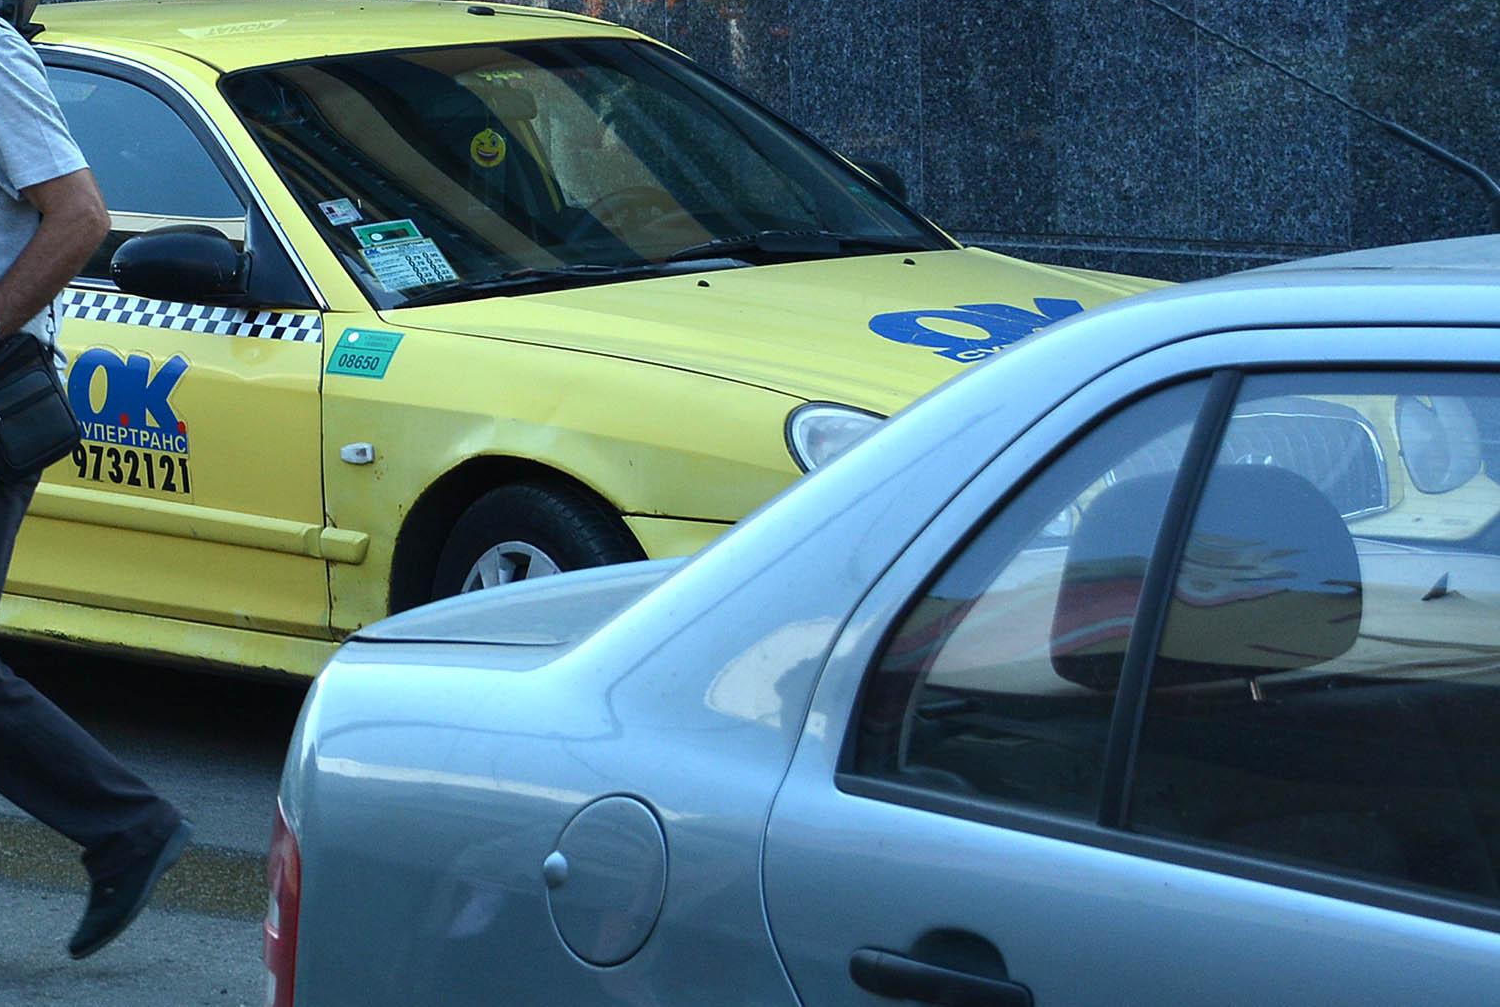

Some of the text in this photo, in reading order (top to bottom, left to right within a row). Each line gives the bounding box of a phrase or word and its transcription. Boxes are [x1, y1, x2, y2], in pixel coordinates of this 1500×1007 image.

[338, 353, 380, 371] 08650
[79, 422, 187, 453] УПЕРТРАНС
[72, 444, 190, 494] 9732121
